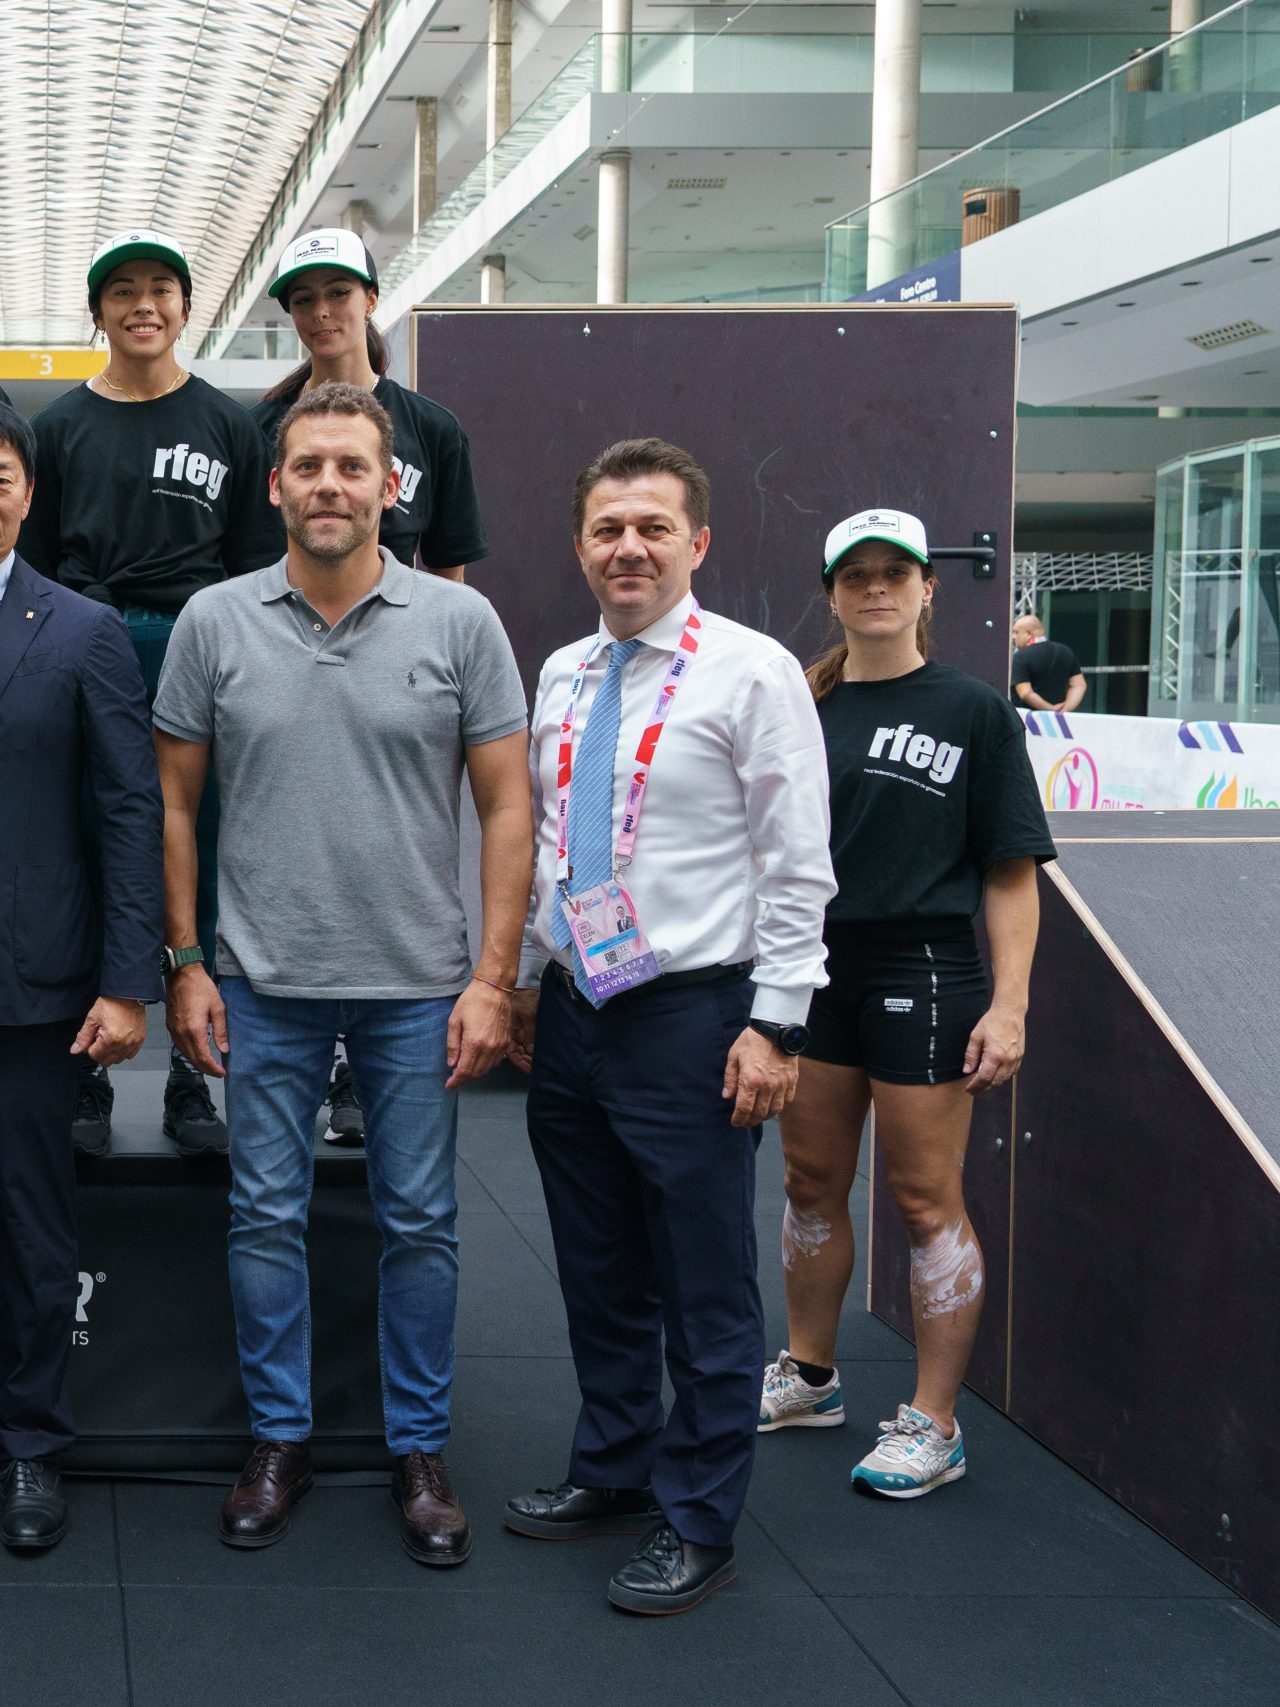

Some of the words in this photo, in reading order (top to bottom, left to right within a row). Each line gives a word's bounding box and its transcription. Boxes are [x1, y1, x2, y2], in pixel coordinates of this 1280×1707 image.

[40, 354, 53, 375] 3
[153, 444, 229, 500] rfeg
[671, 658, 685, 677] rfeg
[867, 724, 964, 784] rfeg
[623, 814, 634, 834] rfeg
